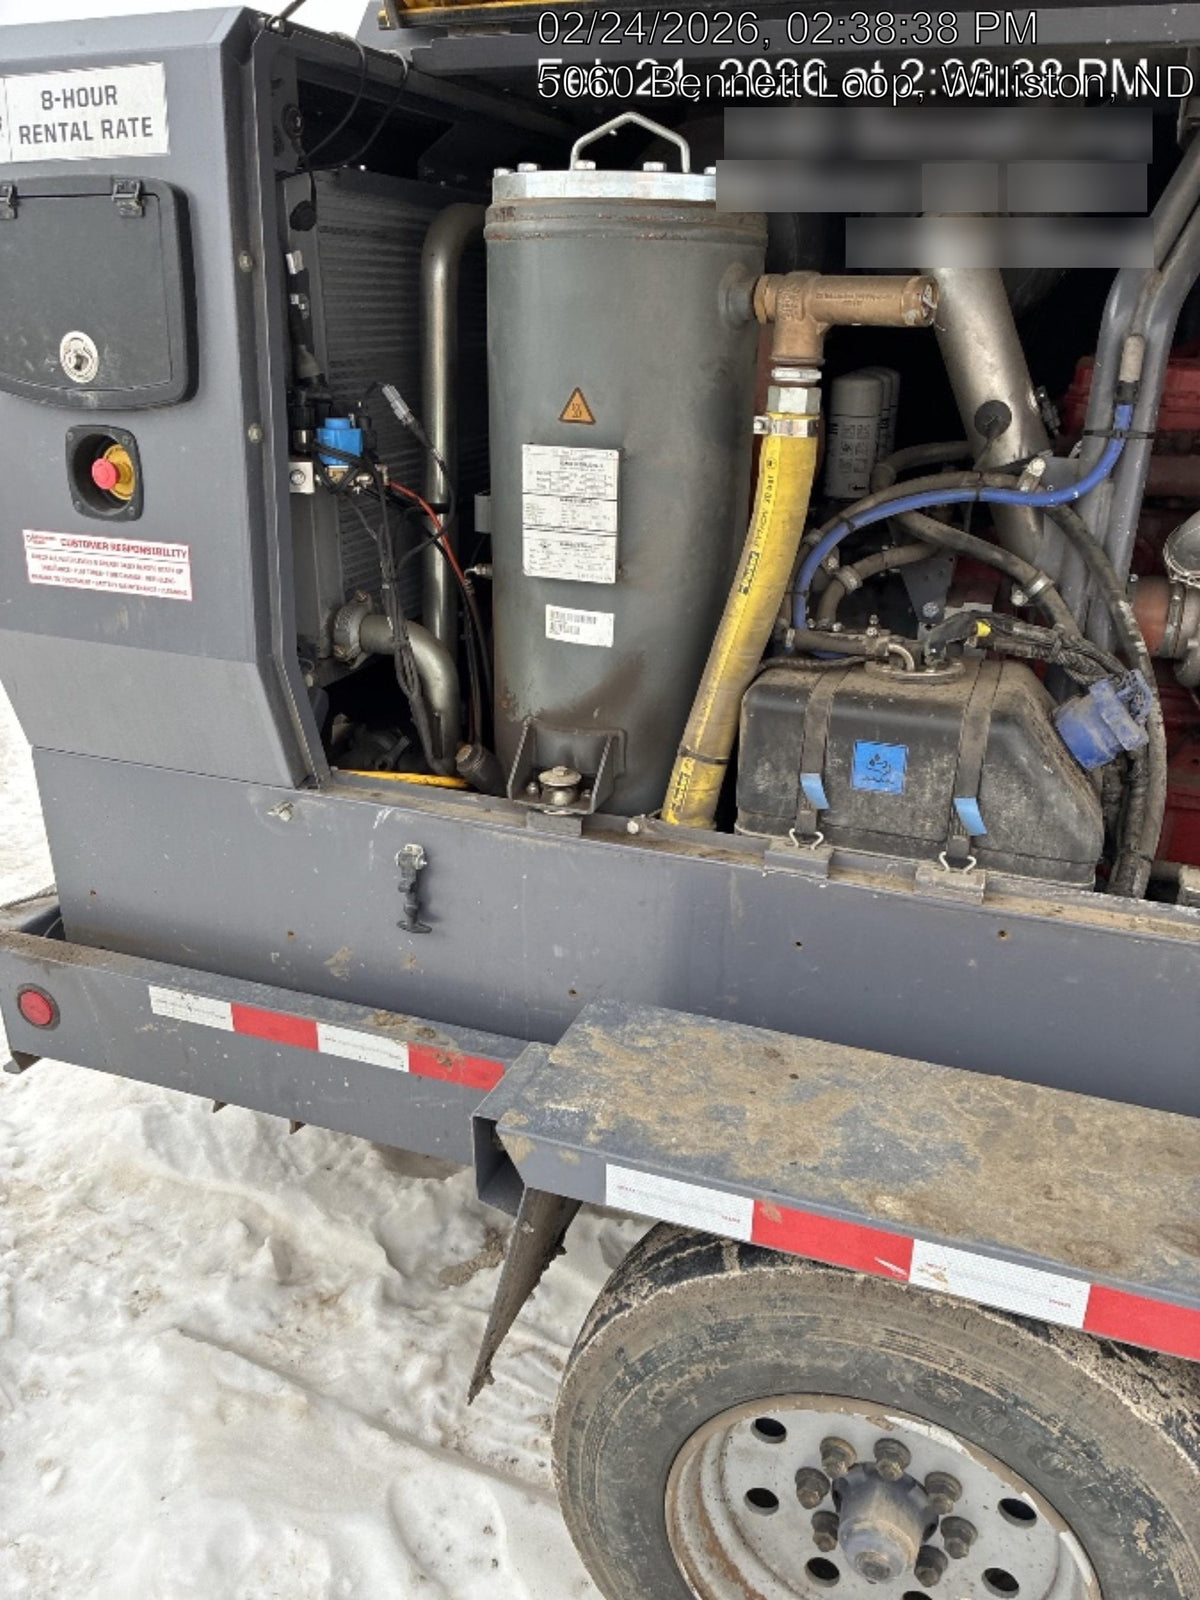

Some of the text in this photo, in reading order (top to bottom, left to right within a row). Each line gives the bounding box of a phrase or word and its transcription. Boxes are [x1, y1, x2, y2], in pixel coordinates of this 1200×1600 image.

[41, 85, 118, 110] 8-HOUR
[19, 121, 94, 144] RENTAL
[101, 116, 154, 139] RATE
[60, 538, 109, 551] CUSTOMER
[111, 543, 187, 559] RESPONSIBILITY
